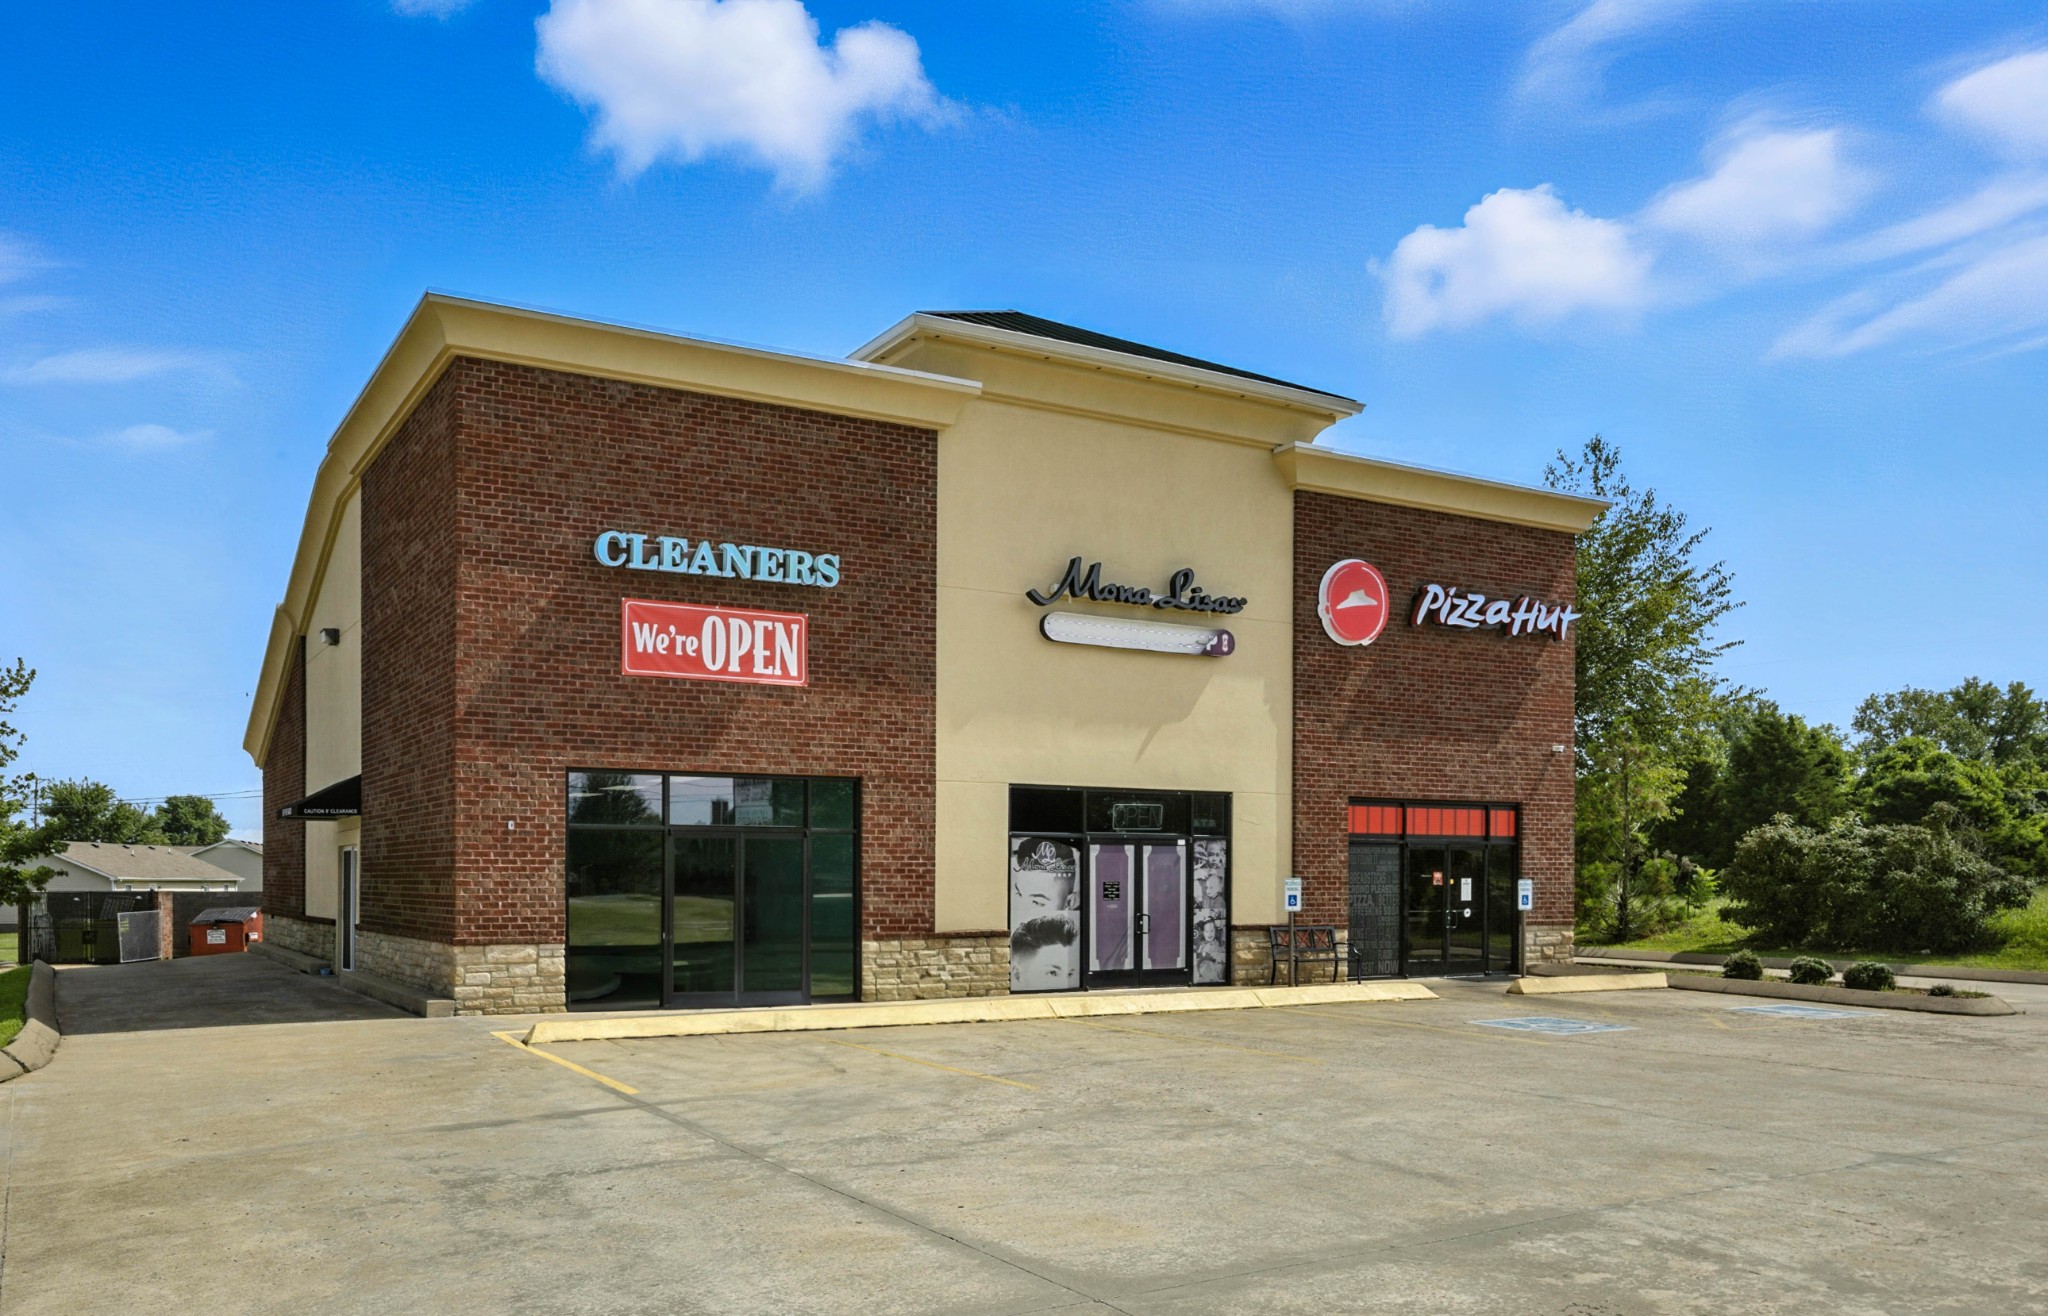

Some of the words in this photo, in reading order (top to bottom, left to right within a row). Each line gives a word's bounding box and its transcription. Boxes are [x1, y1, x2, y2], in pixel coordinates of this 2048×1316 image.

[594, 530, 840, 588] CLEANERS
[1026, 556, 1153, 606] Mona
[1413, 584, 1512, 628] Pizza
[1509, 596, 1582, 641] Hut
[631, 621, 699, 657] We're
[701, 615, 800, 677] OPEN
[1115, 805, 1161, 827] OPEN
[1378, 960, 1399, 974] NOW
